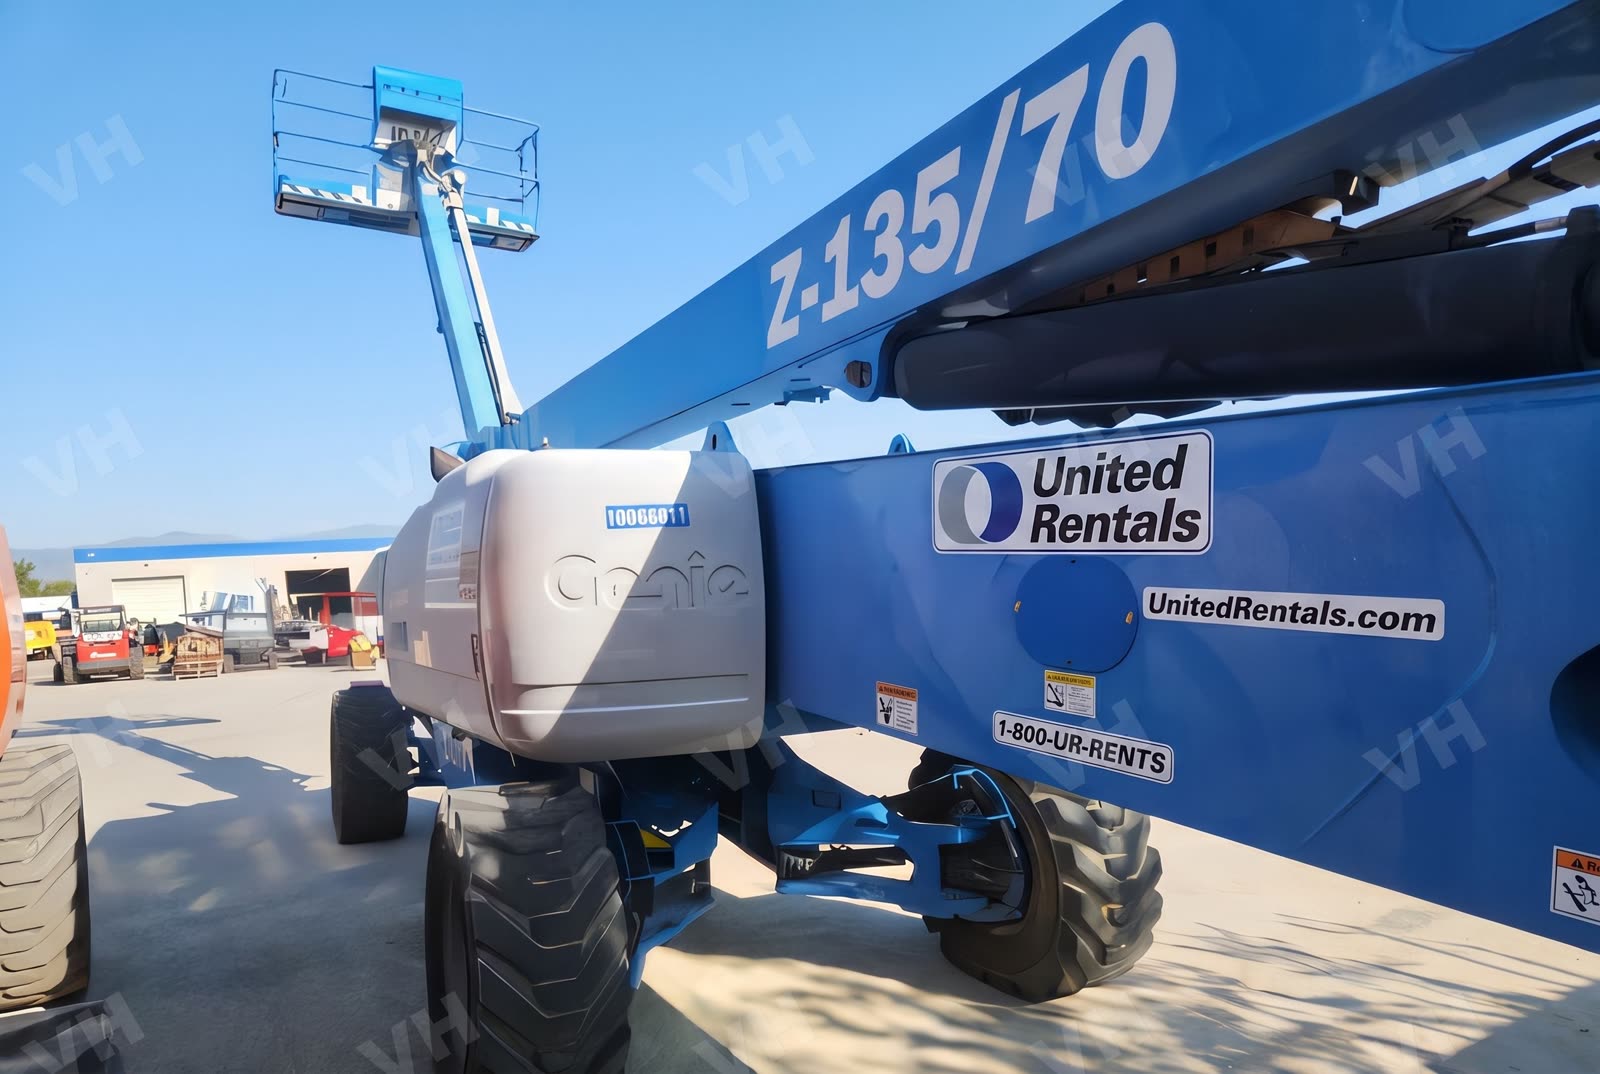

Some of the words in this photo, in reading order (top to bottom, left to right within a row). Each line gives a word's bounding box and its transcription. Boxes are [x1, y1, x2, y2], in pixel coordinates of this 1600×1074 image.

[767, 22, 1177, 349] Z-135/70
[1033, 443, 1188, 498] United
[1030, 498, 1202, 543] Rentals
[1149, 592, 1437, 633] UnitedRentals.com
[999, 719, 1166, 774] 1-800-UR-RENTS
